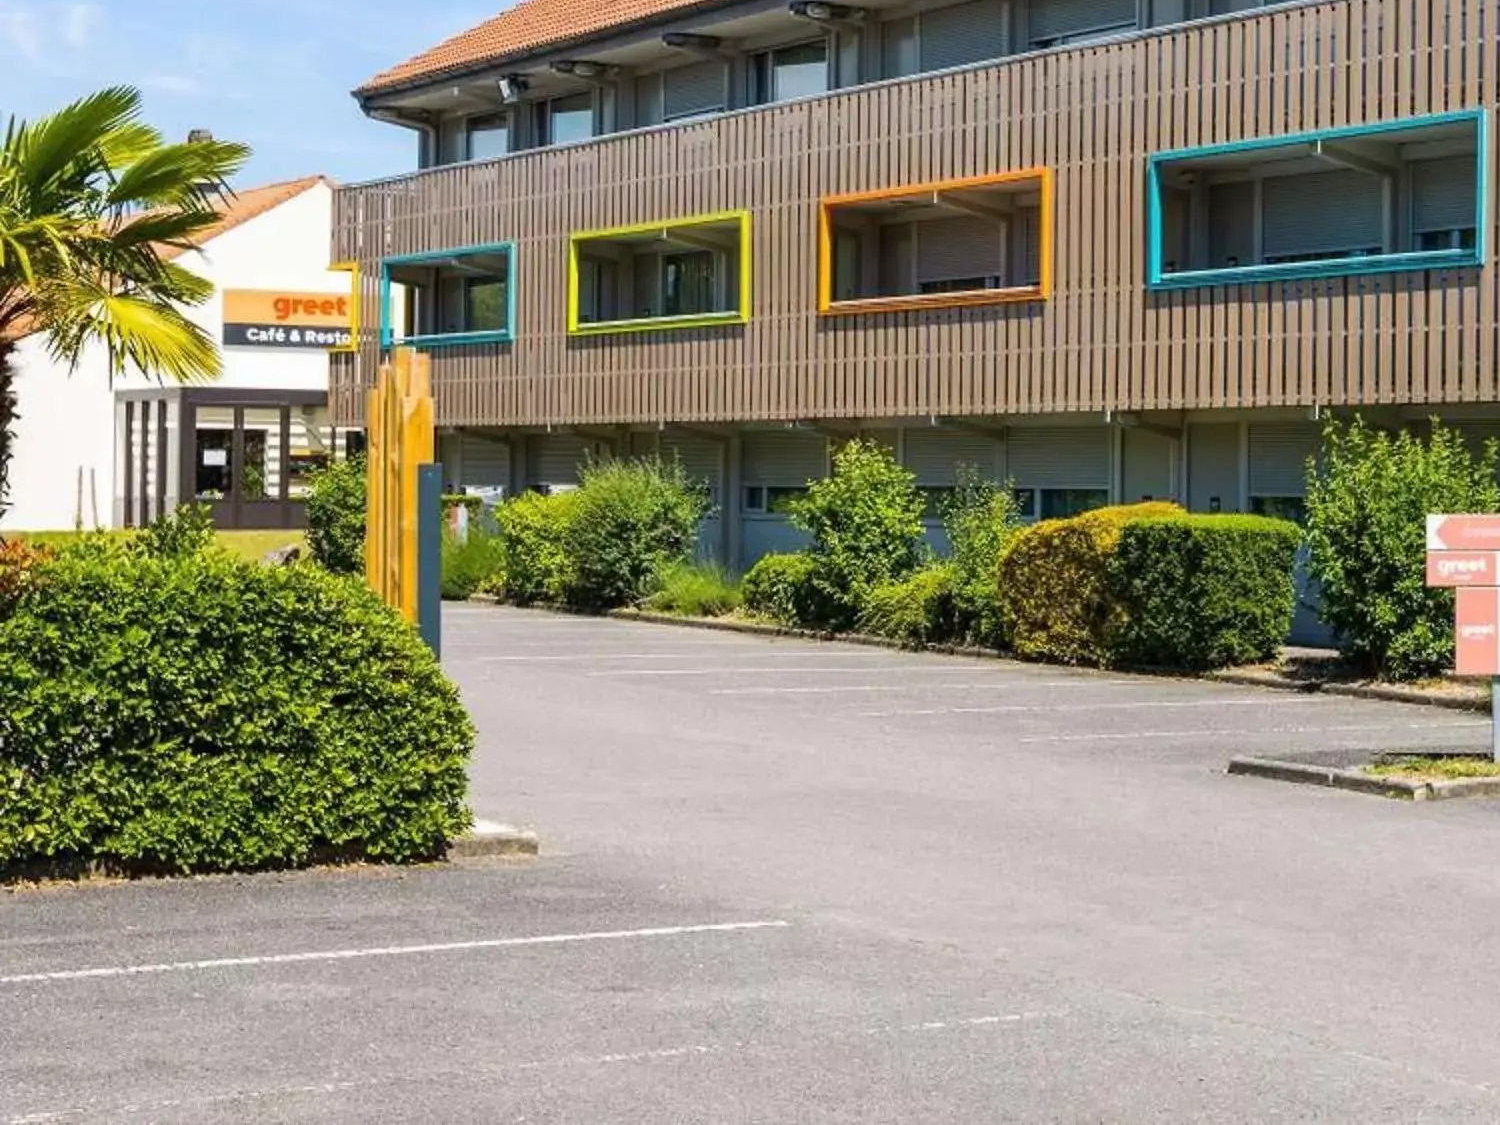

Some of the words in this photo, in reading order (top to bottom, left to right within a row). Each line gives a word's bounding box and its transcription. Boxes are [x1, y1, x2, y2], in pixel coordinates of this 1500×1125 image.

[274, 296, 347, 320] greet
[246, 327, 285, 342] Café
[290, 329, 301, 342] &
[1438, 557, 1487, 578] greet
